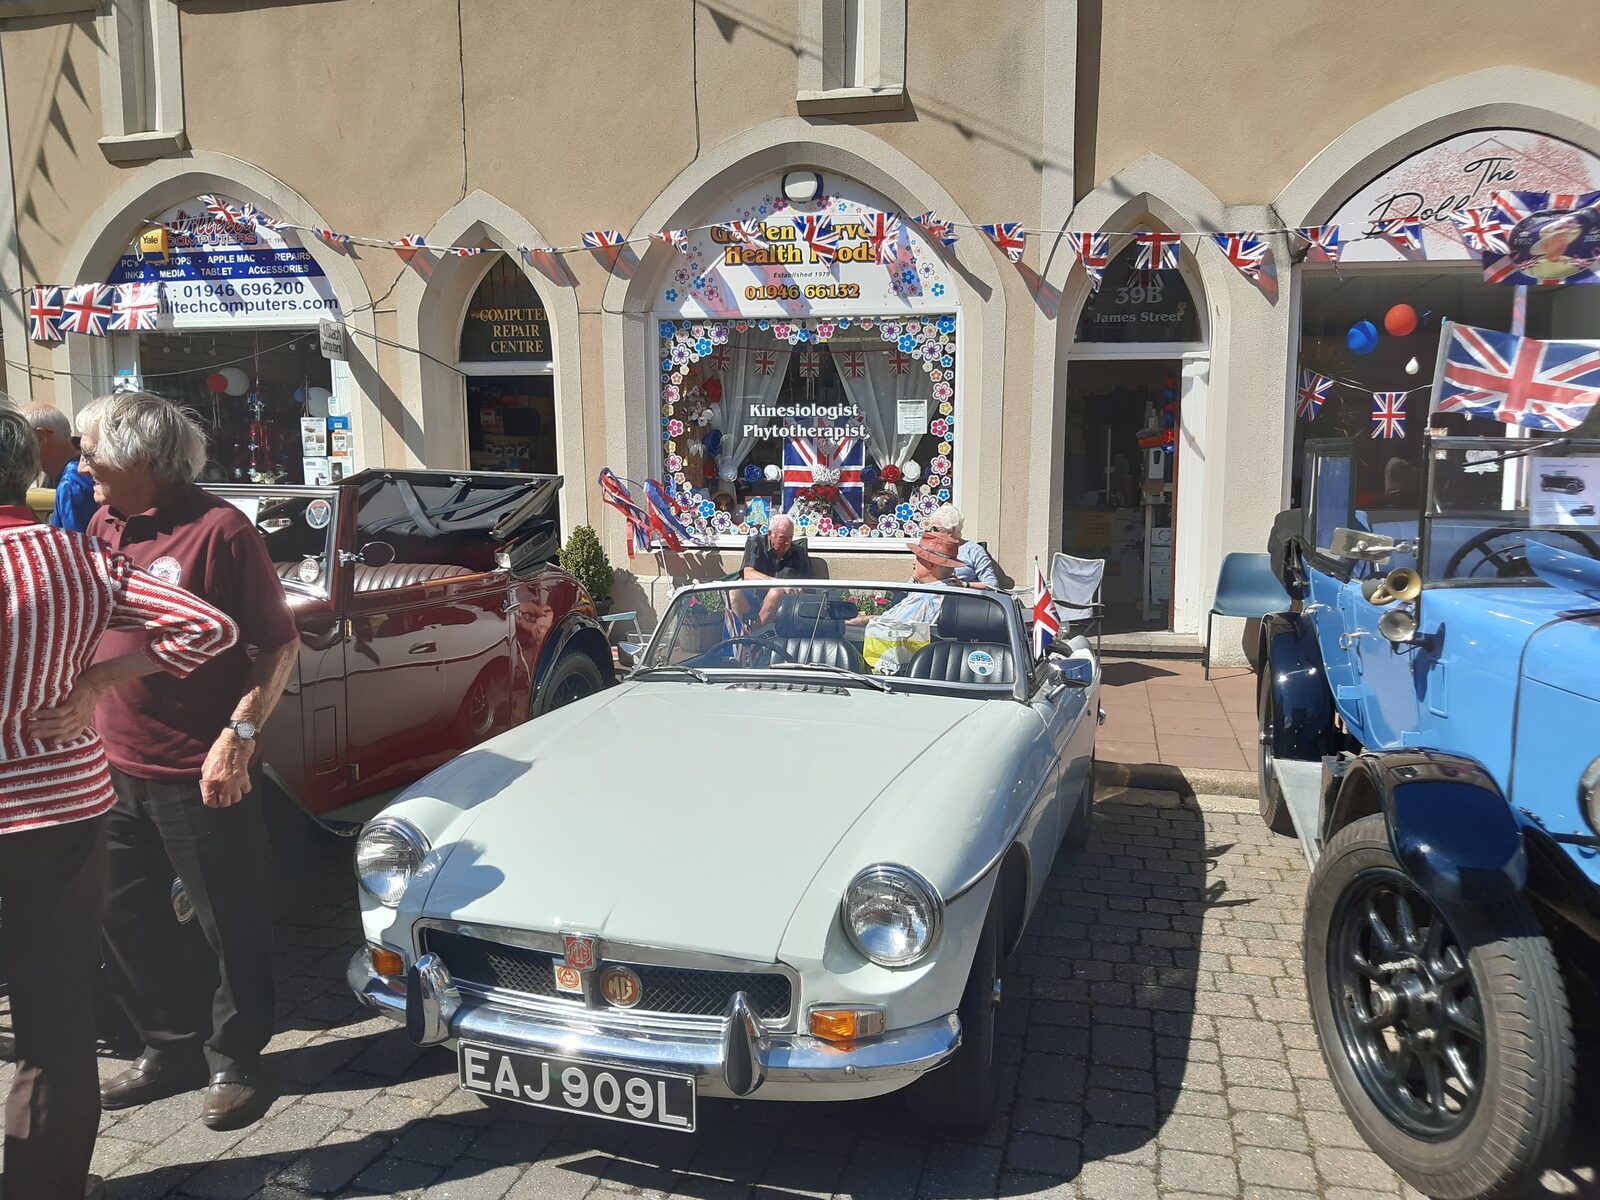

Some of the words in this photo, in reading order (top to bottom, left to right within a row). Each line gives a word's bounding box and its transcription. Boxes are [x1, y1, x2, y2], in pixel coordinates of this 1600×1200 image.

[1464, 157, 1520, 197] The
[143, 236, 159, 245] Yale
[207, 255, 235, 264] APPLE
[237, 254, 256, 263] MAC
[275, 252, 311, 262] REPAIRS
[724, 244, 803, 266] Health
[125, 271, 145, 280] INKS
[159, 269, 186, 278] MEDIA
[201, 267, 233, 277] TABLET
[248, 264, 309, 275] ACCESSORIES
[773, 271, 813, 279] Established
[183, 283, 235, 298] 01946
[241, 282, 304, 296] 696200
[745, 285, 800, 301] 01946
[804, 284, 860, 300] 66132
[1115, 286, 1163, 304] 39B
[1093, 312, 1137, 323] James
[1140, 311, 1183, 322] Street
[493, 325, 540, 337] REPAIR
[491, 340, 544, 353] CENTRE
[749, 402, 860, 418] Kinesiologist
[570, 942, 588, 962] MG
[608, 976, 633, 999] MG
[464, 1048, 550, 1101] EAJ
[561, 1067, 688, 1126] 909L
